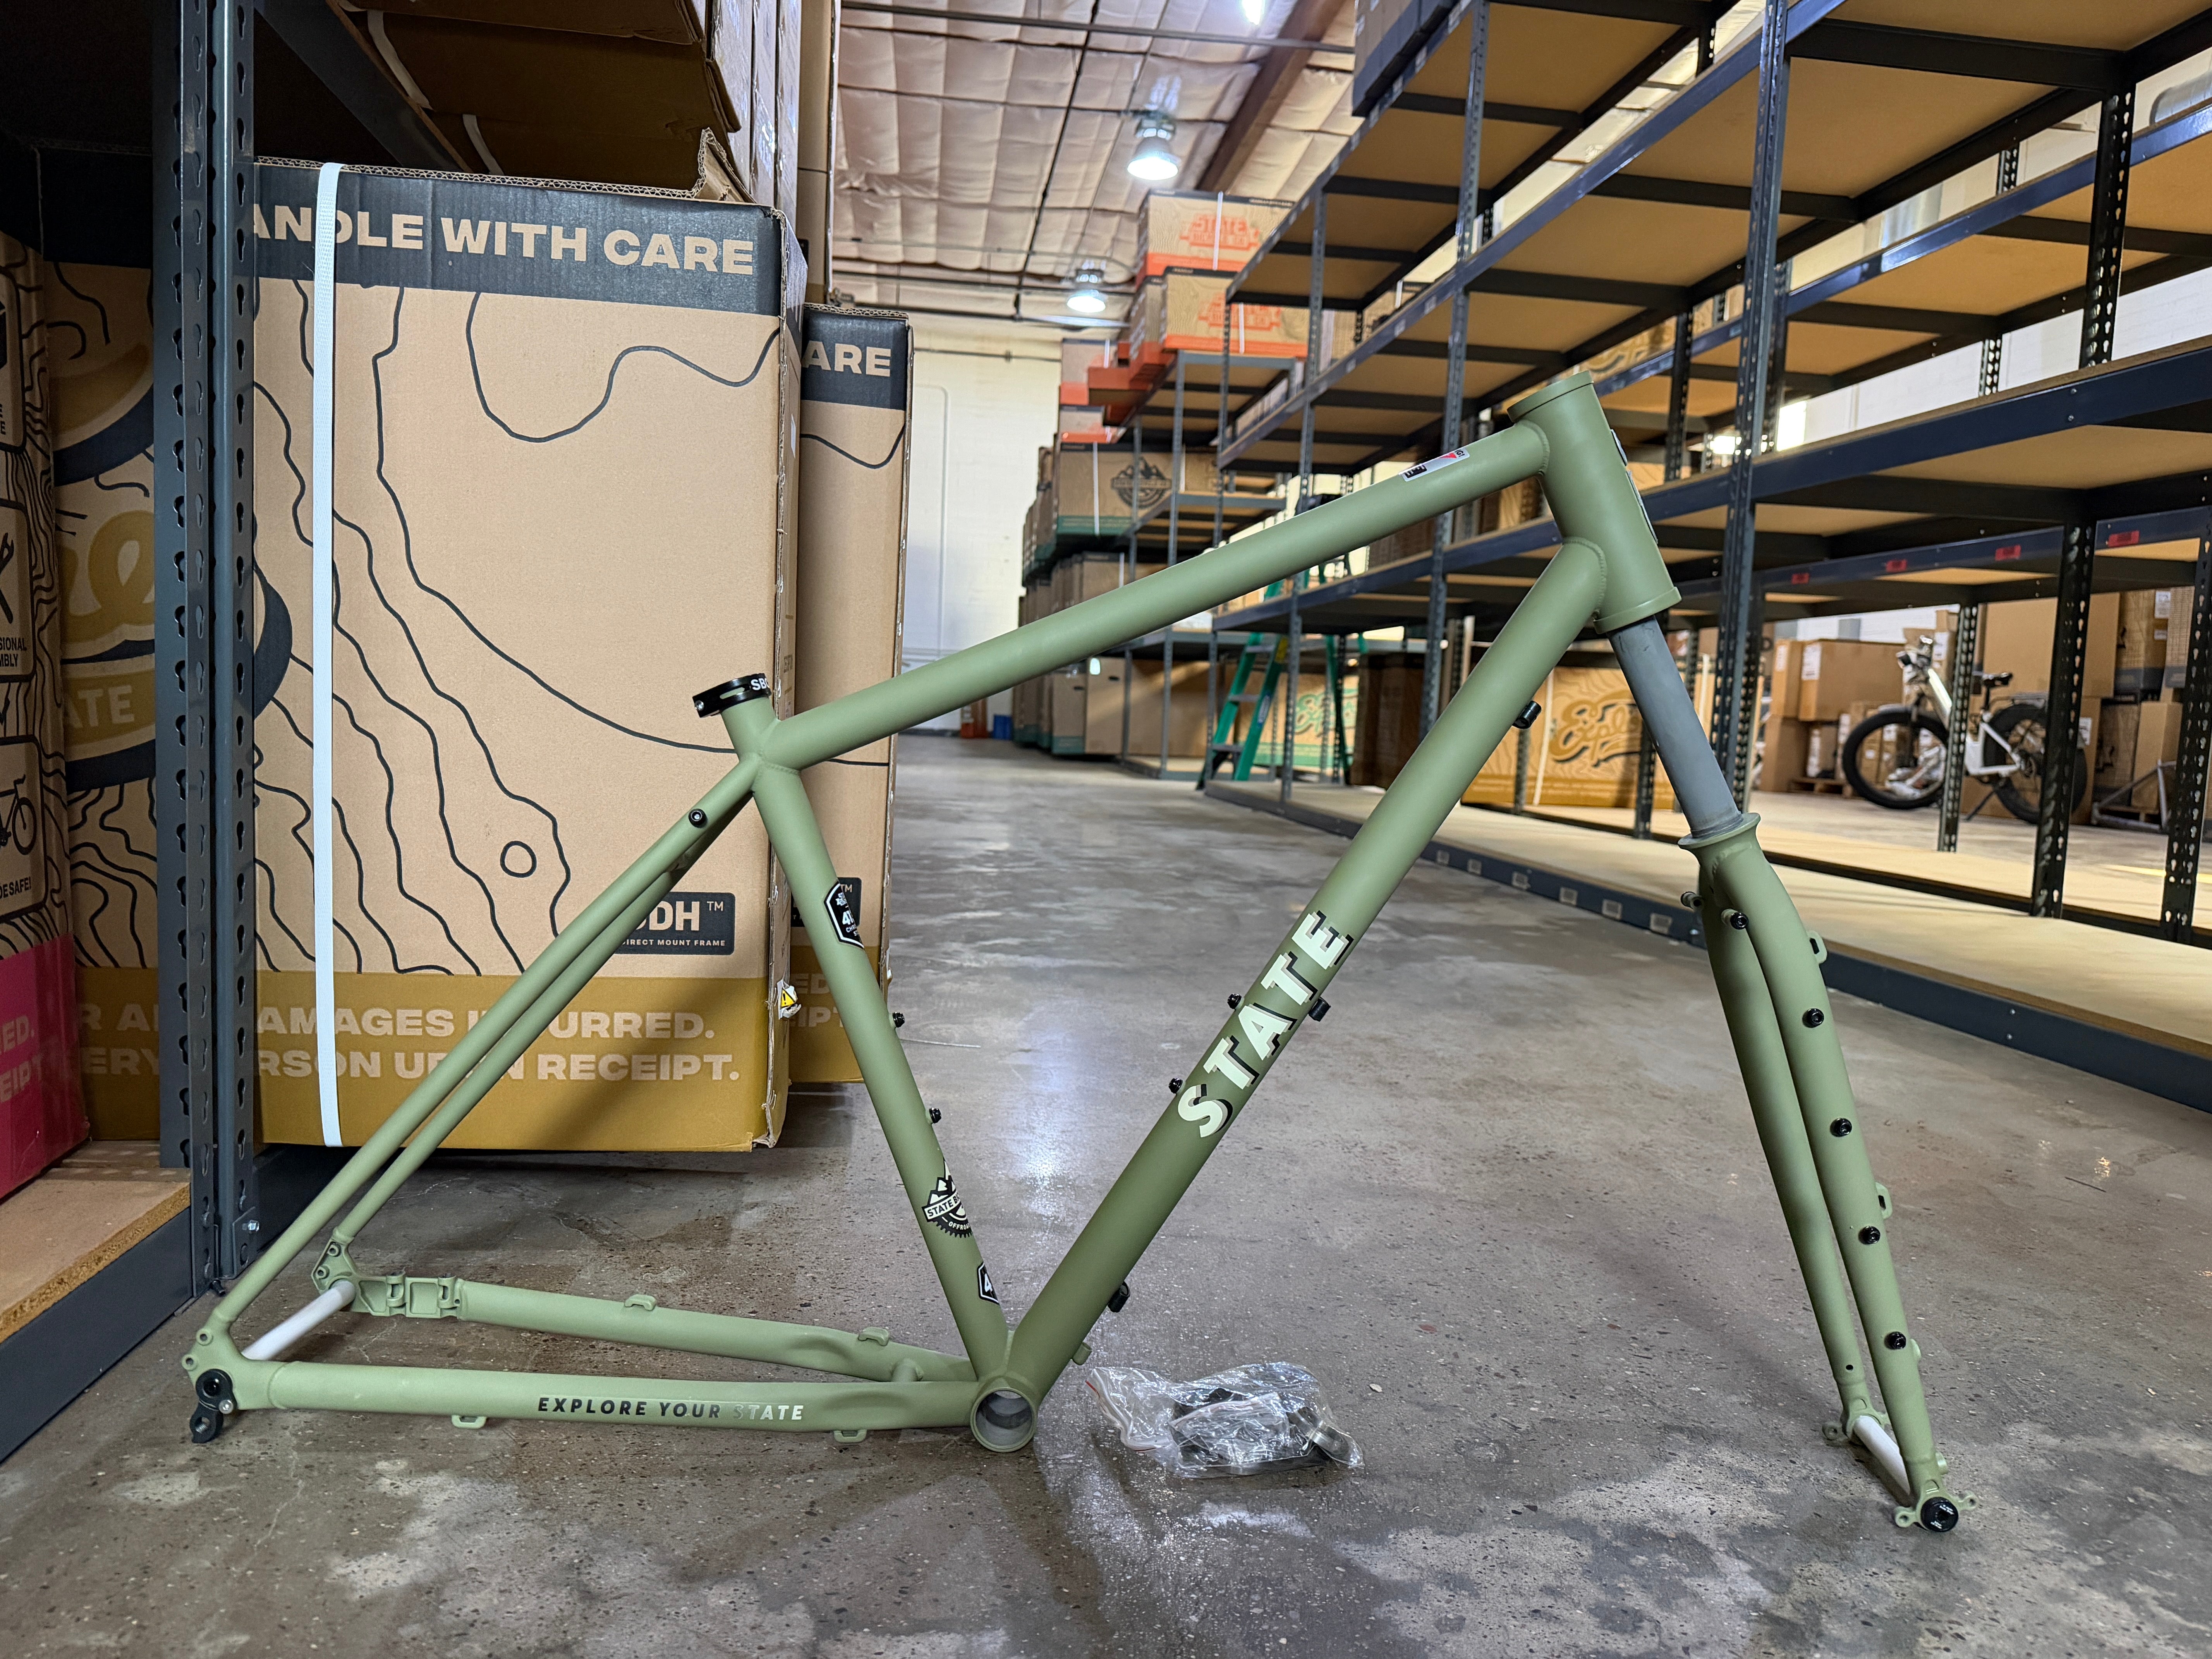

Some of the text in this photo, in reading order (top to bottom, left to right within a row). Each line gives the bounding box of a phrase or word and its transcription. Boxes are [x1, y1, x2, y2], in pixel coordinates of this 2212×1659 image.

[254, 204, 753, 275] ANDLE WITH CARE
[802, 341, 891, 377] ARE
[707, 901, 723, 911] TM
[0, 1015, 34, 1053] ED.
[256, 1006, 455, 1037] AMAGES
[1178, 910, 1354, 1138] STATE
[538, 1054, 739, 1080] RECEIPT.
[927, 1199, 953, 1217] STATE
[538, 1397, 804, 1420] EXPLORE YOUR STATE
